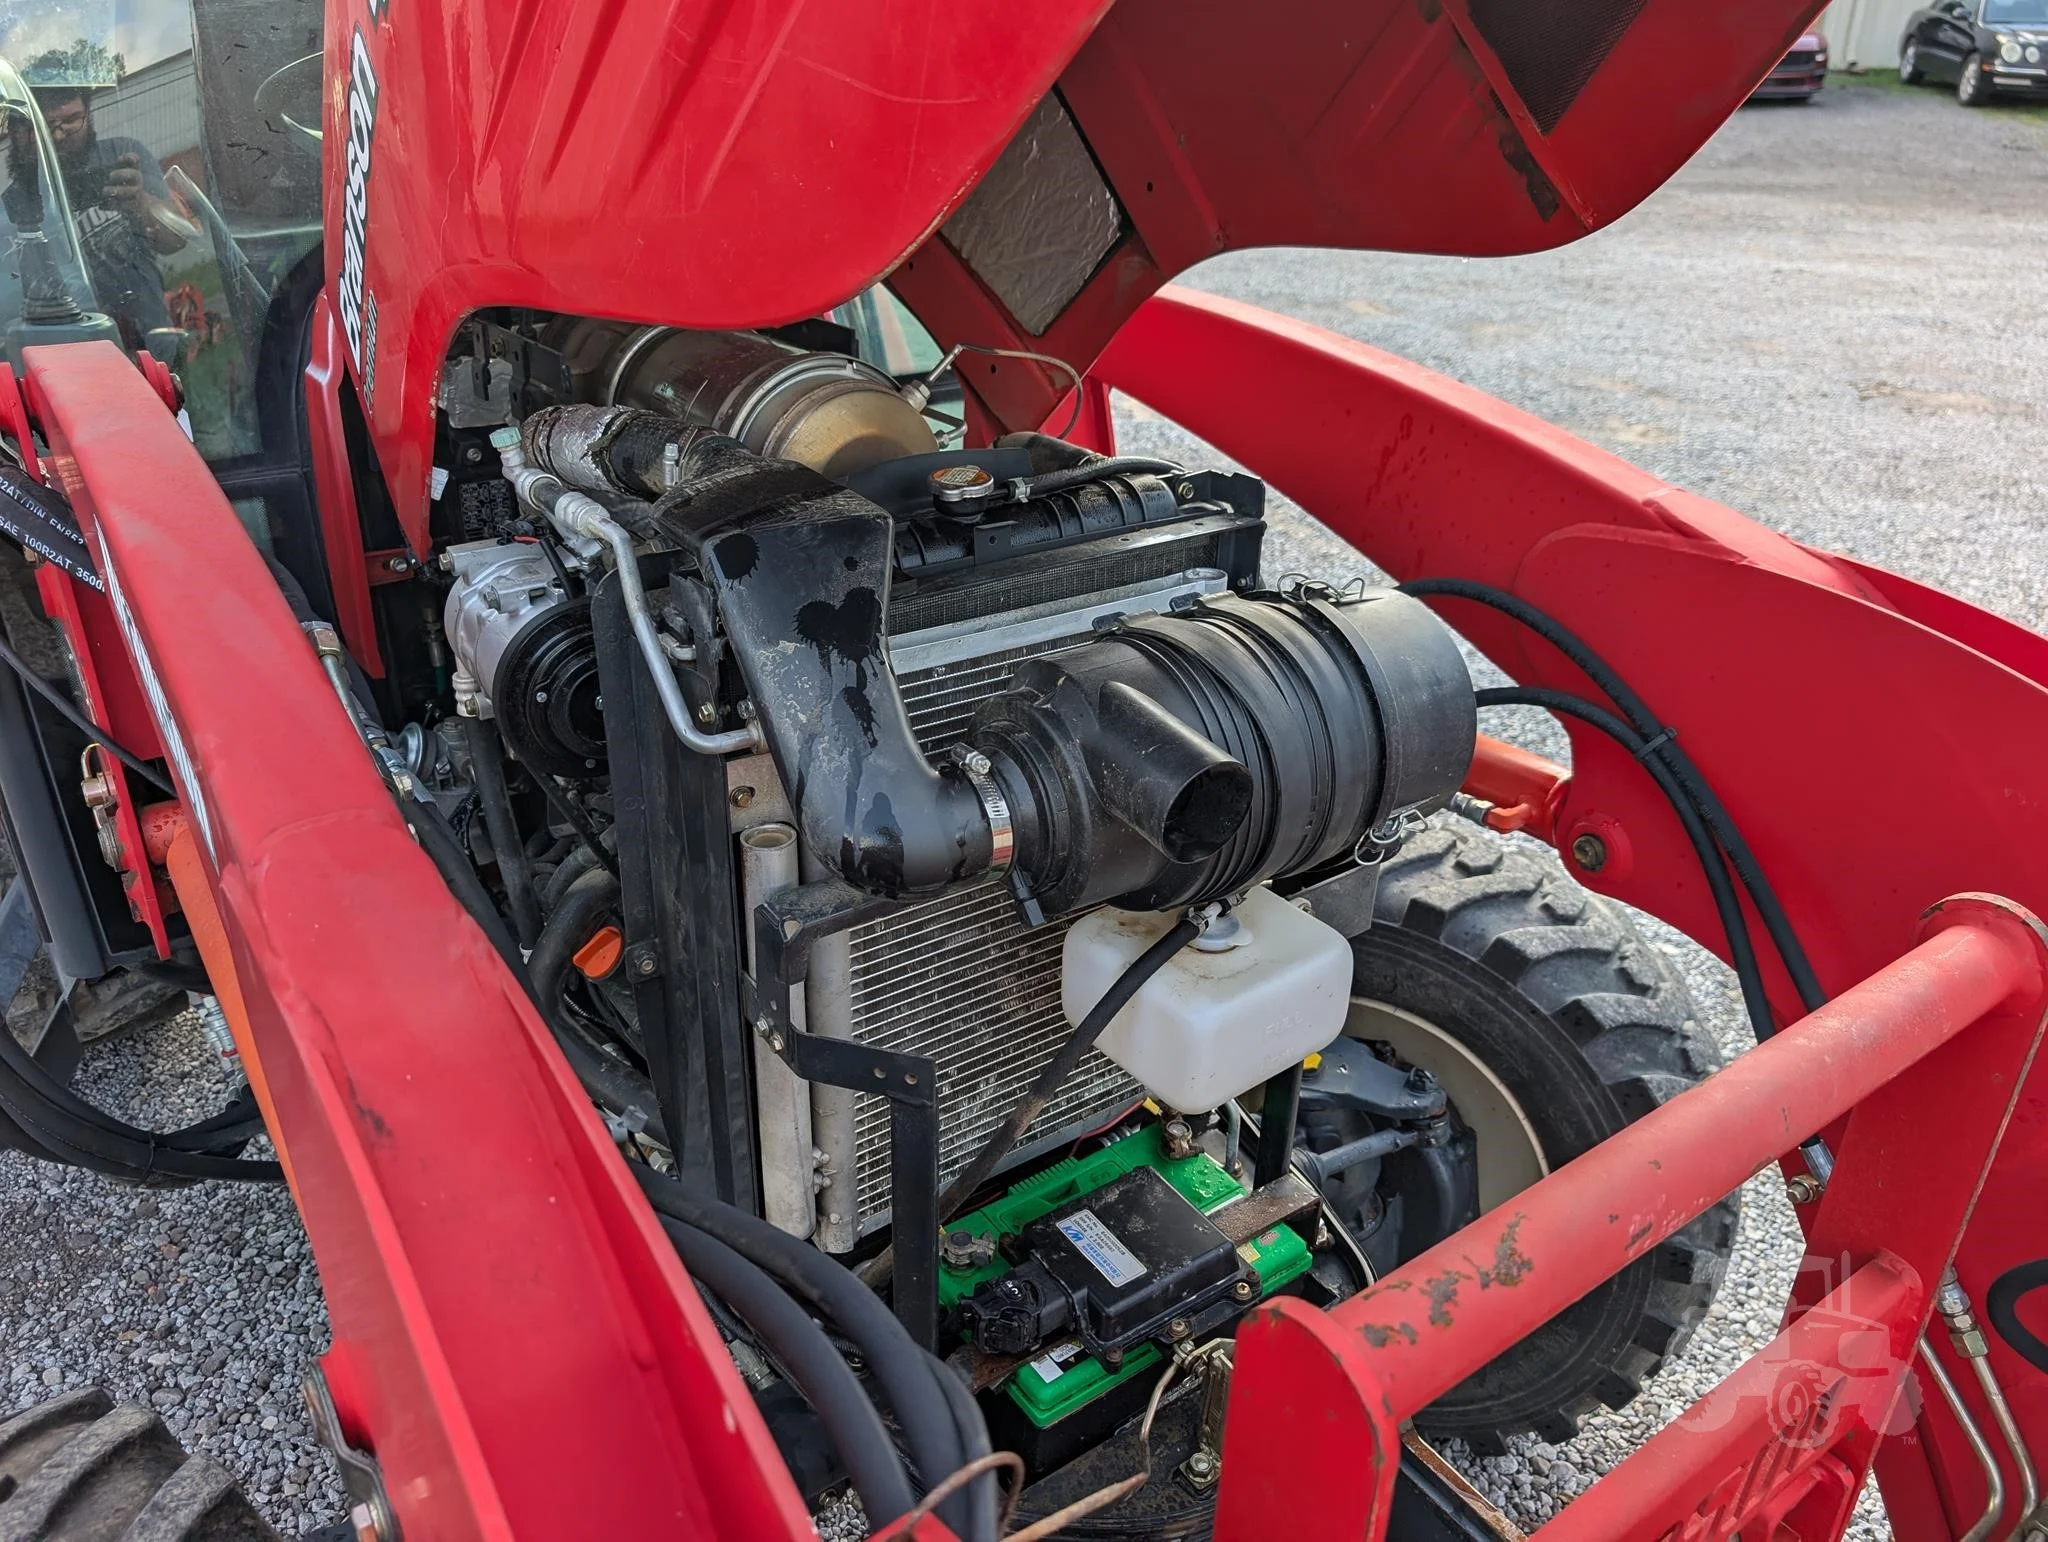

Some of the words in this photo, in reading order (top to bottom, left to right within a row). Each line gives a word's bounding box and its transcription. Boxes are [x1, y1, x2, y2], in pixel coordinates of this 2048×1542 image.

[339, 30, 378, 376] Branson
[0, 516, 20, 537] SAE
[24, 534, 73, 569] 100R2AT
[76, 567, 105, 592] 3500
[1062, 1225, 1084, 1242] KM
